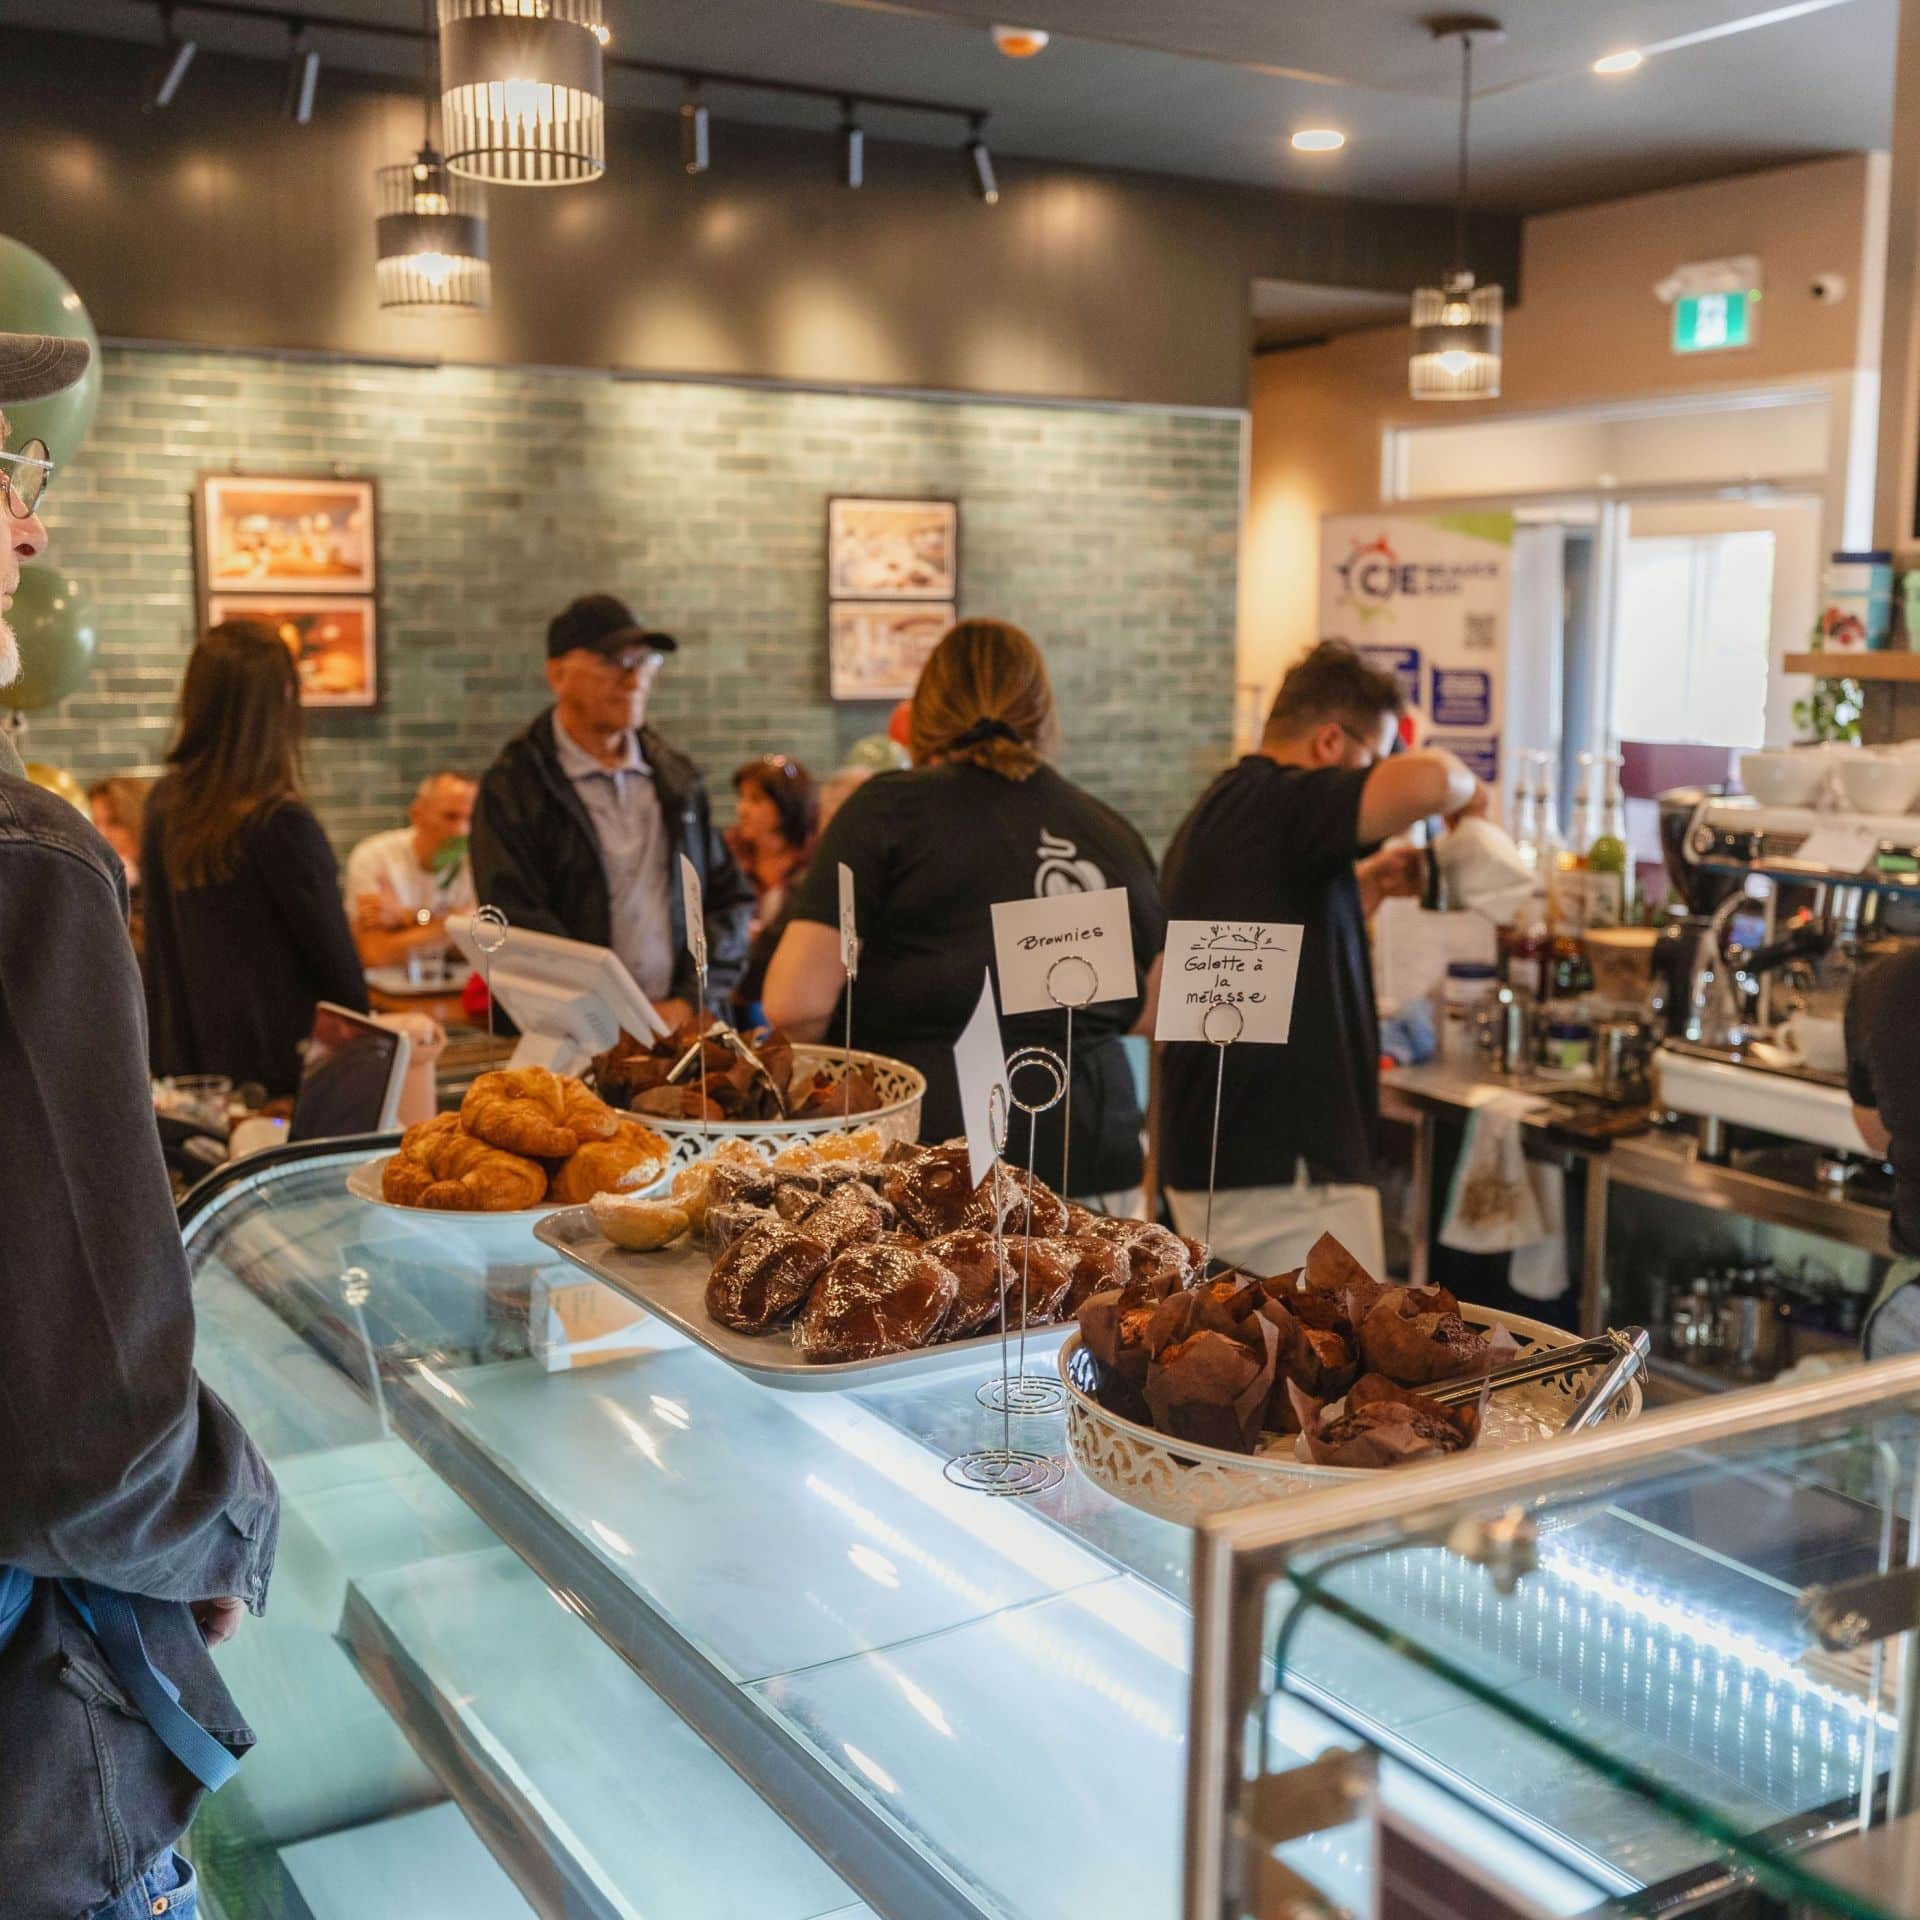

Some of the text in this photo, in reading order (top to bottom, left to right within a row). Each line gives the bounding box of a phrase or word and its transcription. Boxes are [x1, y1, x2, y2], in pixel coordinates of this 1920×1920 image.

[1016, 926, 1104, 951] Brownies
[1253, 958, 1264, 971] à
[1214, 974, 1231, 988] la
[1185, 990, 1267, 1004] mélasse
